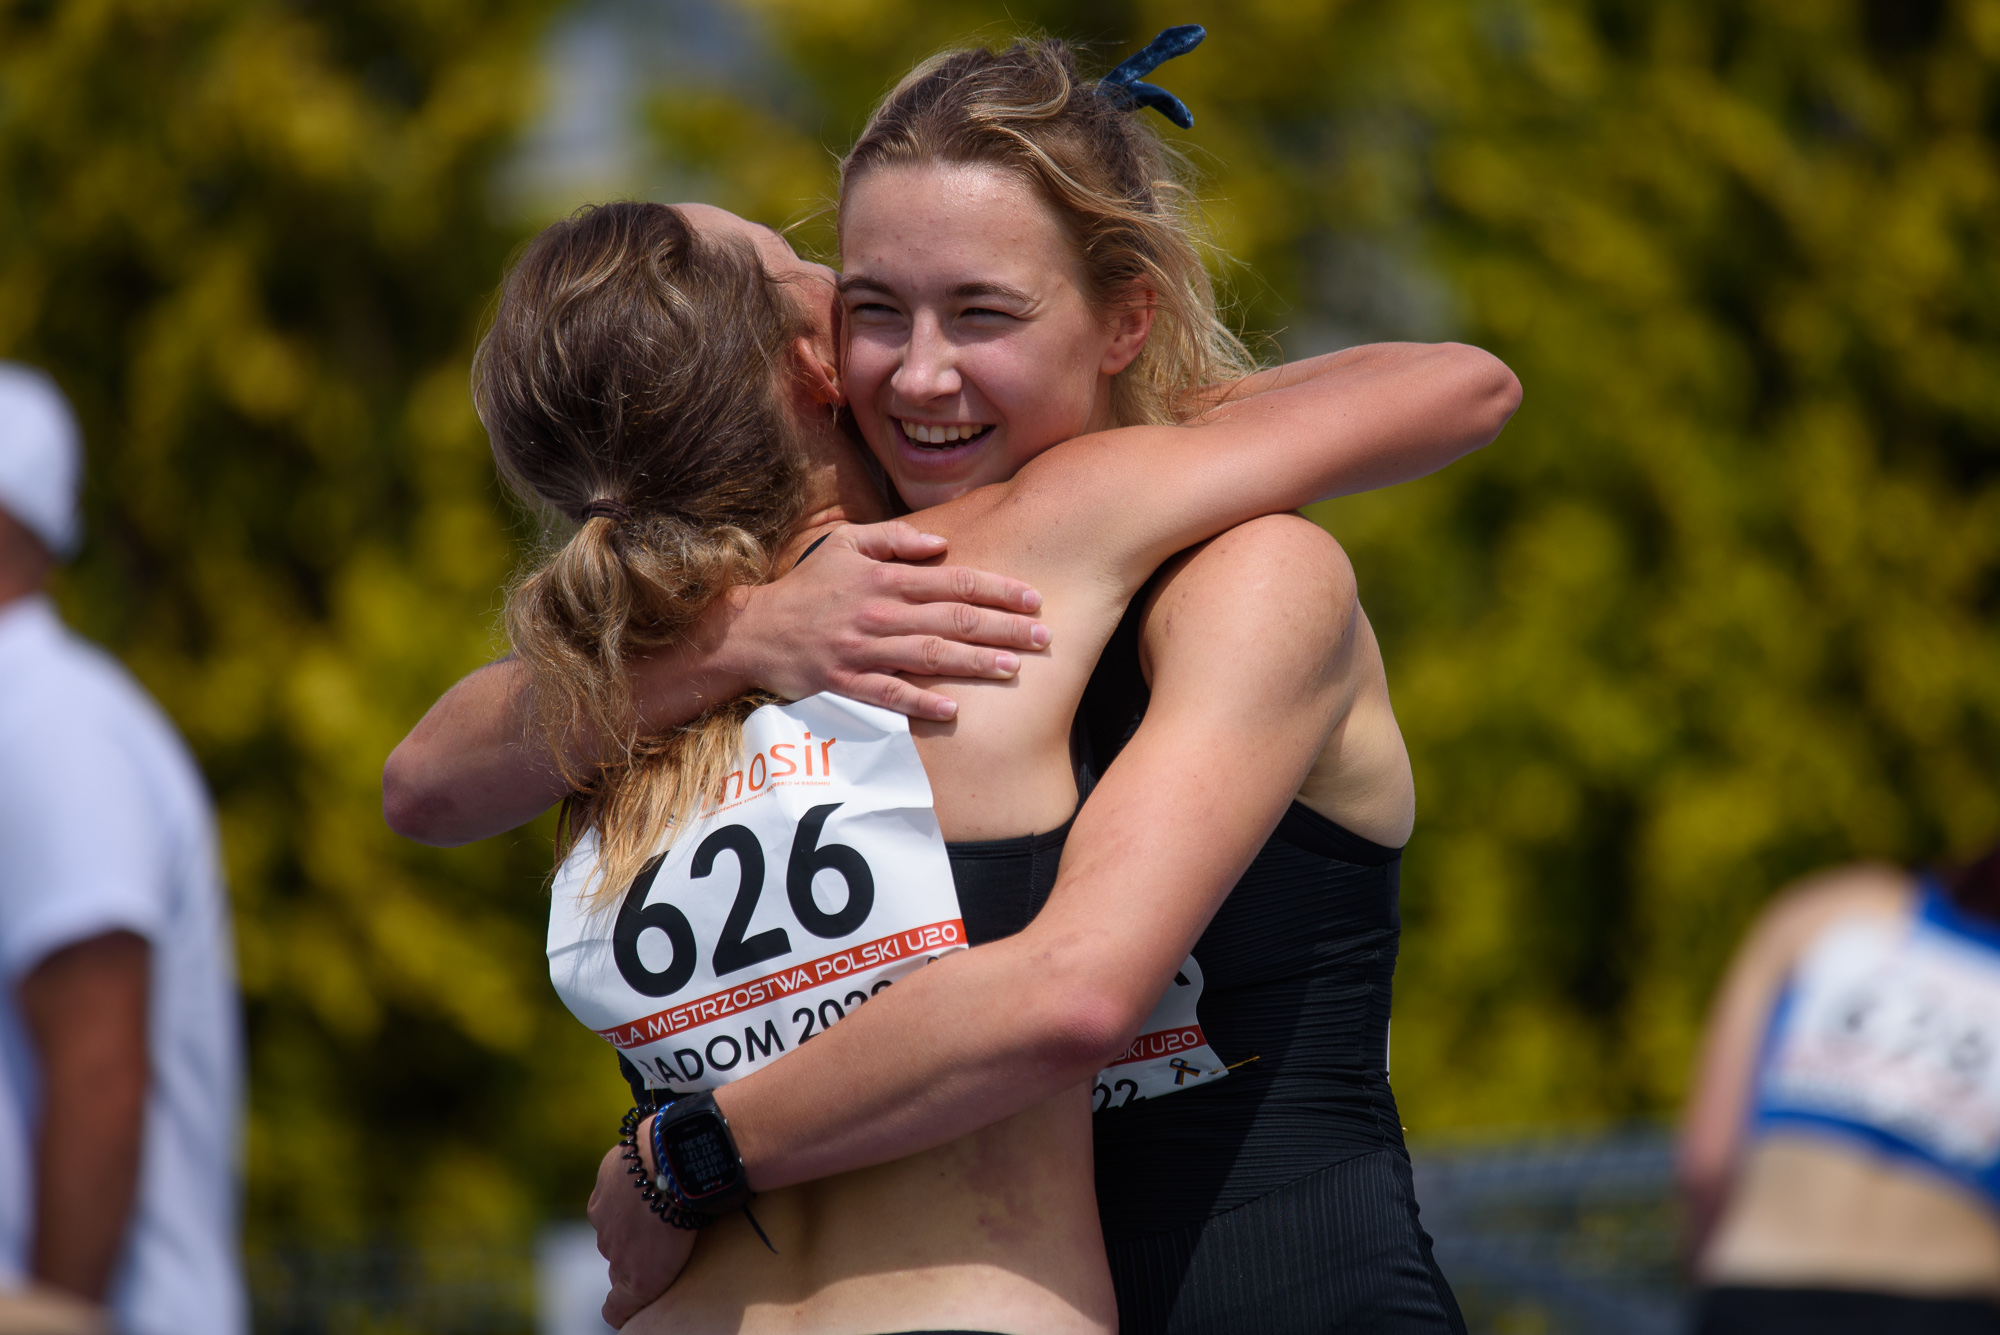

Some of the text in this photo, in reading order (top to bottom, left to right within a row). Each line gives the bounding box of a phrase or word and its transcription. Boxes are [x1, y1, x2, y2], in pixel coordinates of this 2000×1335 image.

[612, 801, 876, 999] 626
[647, 968, 813, 1038] MISTRZOSTWA
[815, 938, 902, 982] POLSKI
[905, 924, 959, 952] U20
[1150, 1030, 1199, 1055] U20
